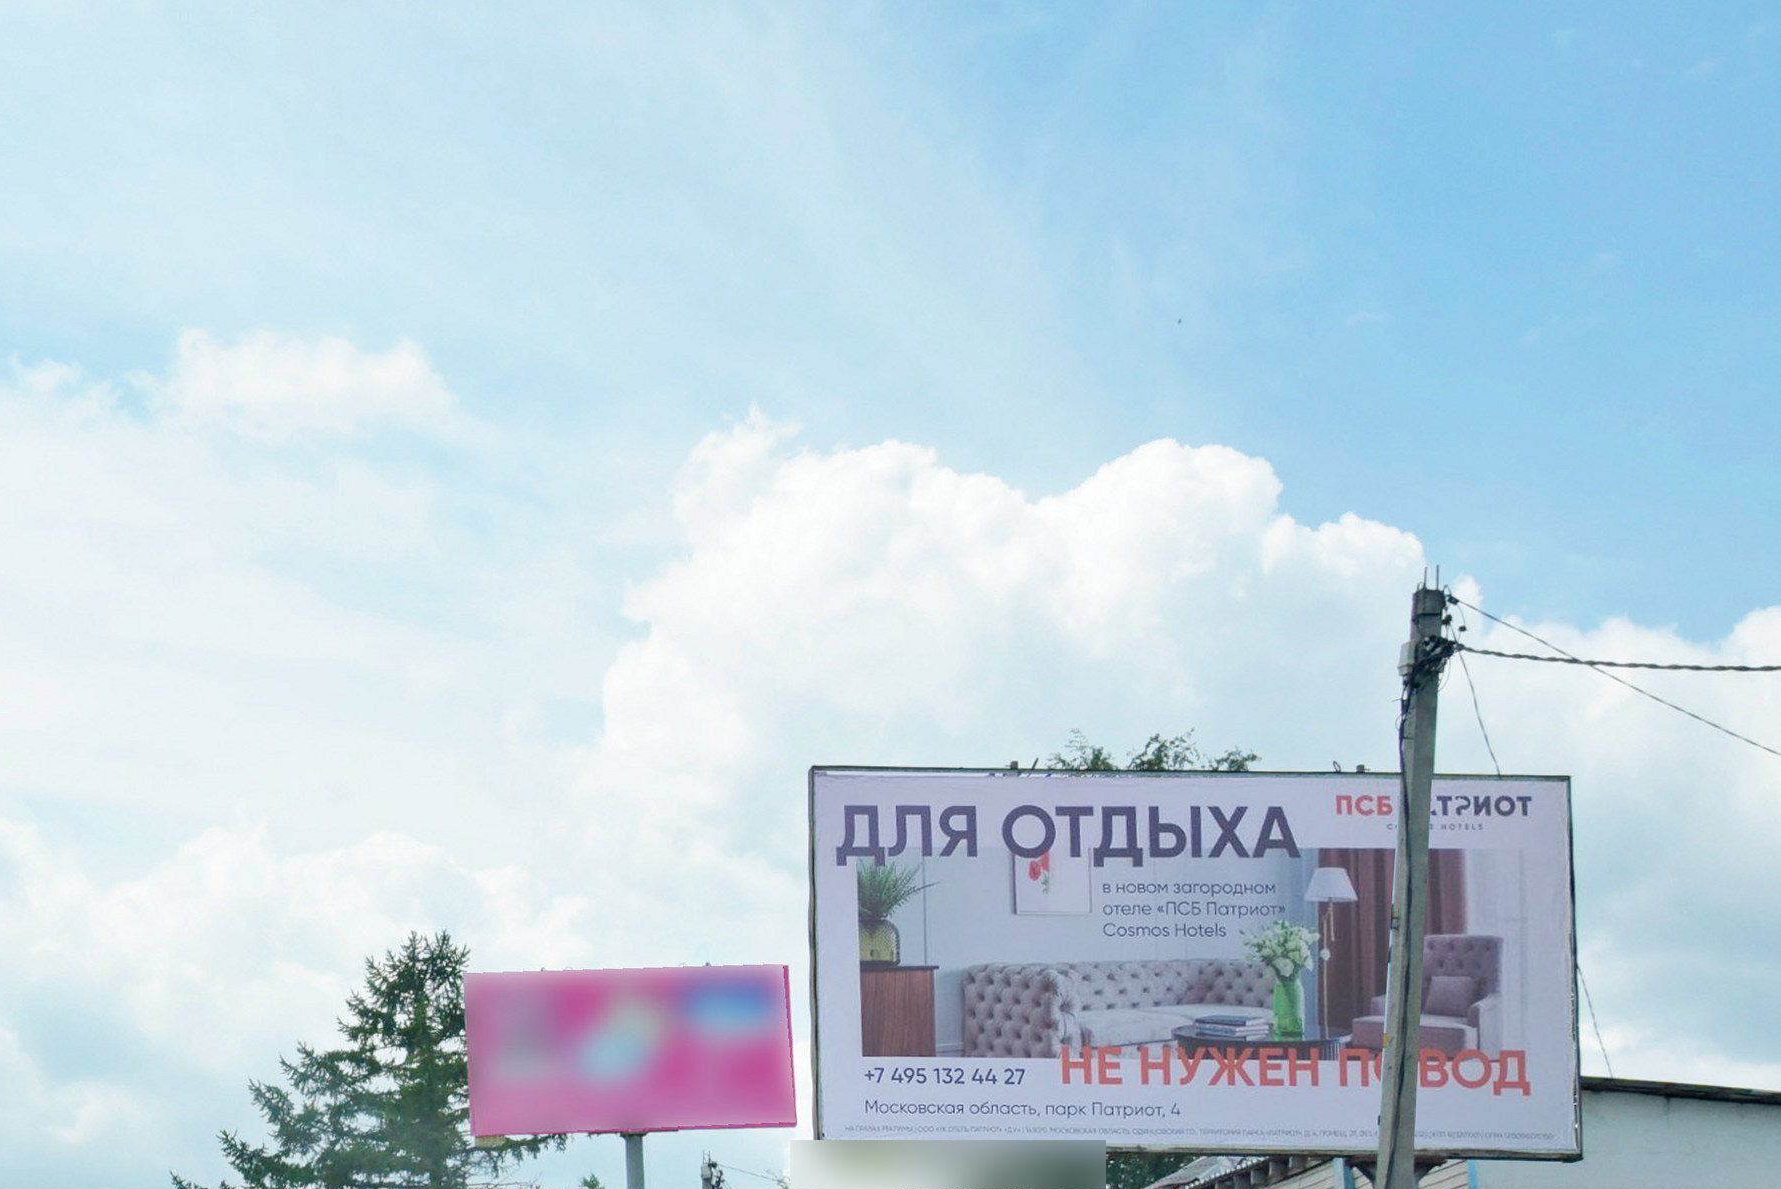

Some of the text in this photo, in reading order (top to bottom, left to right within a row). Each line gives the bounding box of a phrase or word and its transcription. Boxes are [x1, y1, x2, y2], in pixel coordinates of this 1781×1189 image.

[1336, 795, 1532, 816] ПСБ ТРИОТ
[836, 804, 1300, 868] ДЛЯ ОТДЫХА
[1441, 823, 1484, 831] HOTELS
[1102, 883, 1276, 899] в новом загородном
[1103, 901, 1286, 920] отеле «ПСБ Патриот»
[1103, 922, 1227, 938] Cosmos Hotels
[864, 1067, 1026, 1085] +7 495 132 44 27
[1061, 1044, 1531, 1097] НЕ НУЖЕН ПВОД
[864, 1100, 1181, 1121] Московская область, парк Патриот, 4
